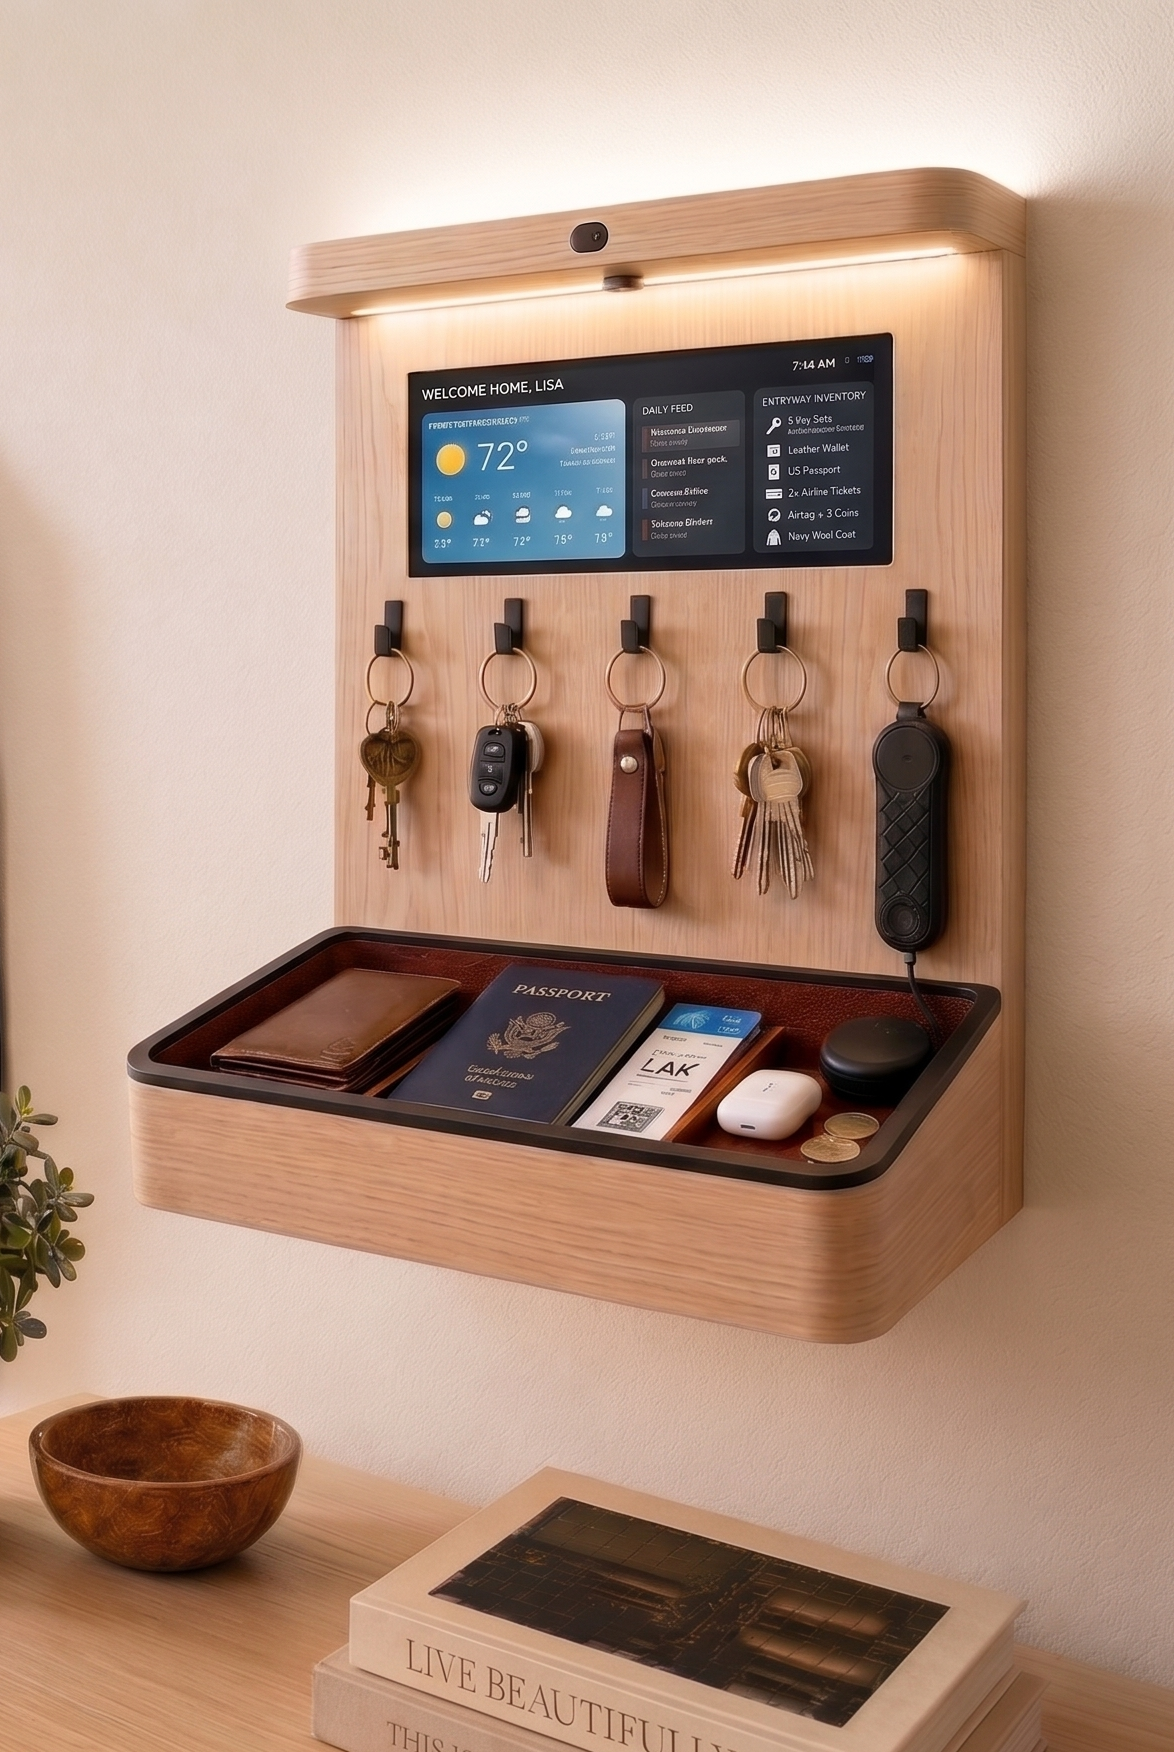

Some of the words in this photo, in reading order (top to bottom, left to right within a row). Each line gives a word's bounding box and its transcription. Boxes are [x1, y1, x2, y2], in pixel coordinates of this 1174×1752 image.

[817, 357, 836, 369] AM
[421, 384, 486, 401] WELCOME
[490, 381, 532, 396] HOME,
[535, 378, 565, 392] LISA
[762, 394, 812, 407] ENTRYWAY
[814, 390, 867, 403] INVENTORY
[642, 405, 669, 416] DAILY
[670, 403, 694, 413] FEED
[813, 414, 833, 424] Sets
[477, 439, 529, 471] 72°
[788, 445, 820, 455] Leather
[822, 443, 850, 453] Wallet
[788, 466, 801, 476] US
[802, 465, 841, 477] Passport
[788, 488, 799, 498] 2x
[801, 487, 829, 497] Airline
[830, 486, 861, 496] Tickets
[787, 510, 815, 521] Airtag
[826, 508, 833, 518] 3
[834, 507, 859, 518] Coins
[788, 531, 810, 542] Navy
[812, 530, 833, 540] Wool
[835, 529, 856, 539] Coat
[512, 983, 611, 1002] PASSPORT
[406, 1638, 476, 1694] LIVE
[386, 1721, 444, 1752] THIS
